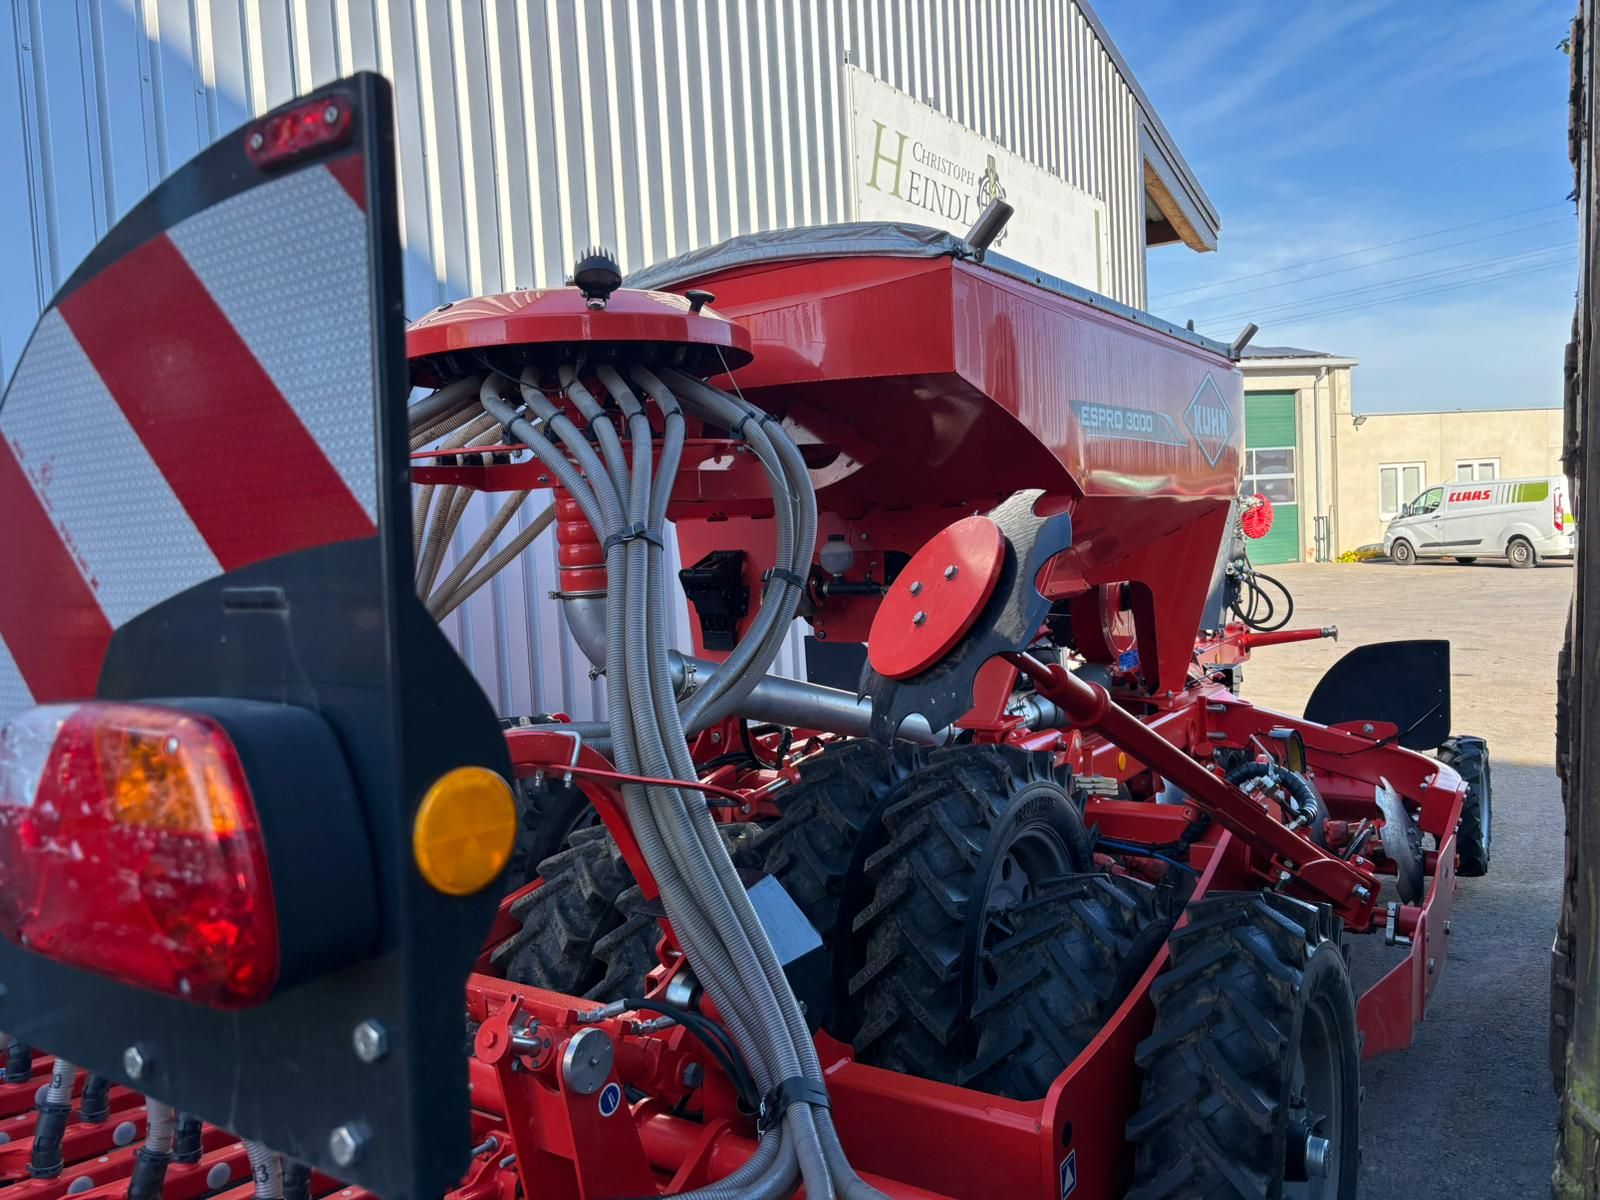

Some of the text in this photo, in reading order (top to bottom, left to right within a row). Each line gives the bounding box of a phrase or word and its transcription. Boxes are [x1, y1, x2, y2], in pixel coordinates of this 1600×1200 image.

[865, 119, 975, 227] HEINDL
[912, 140, 975, 187] CHRISTOPH
[1081, 406, 1153, 432] ESPRO 3000
[1194, 404, 1228, 437] KUHN
[1448, 490, 1491, 502] CLAAS
